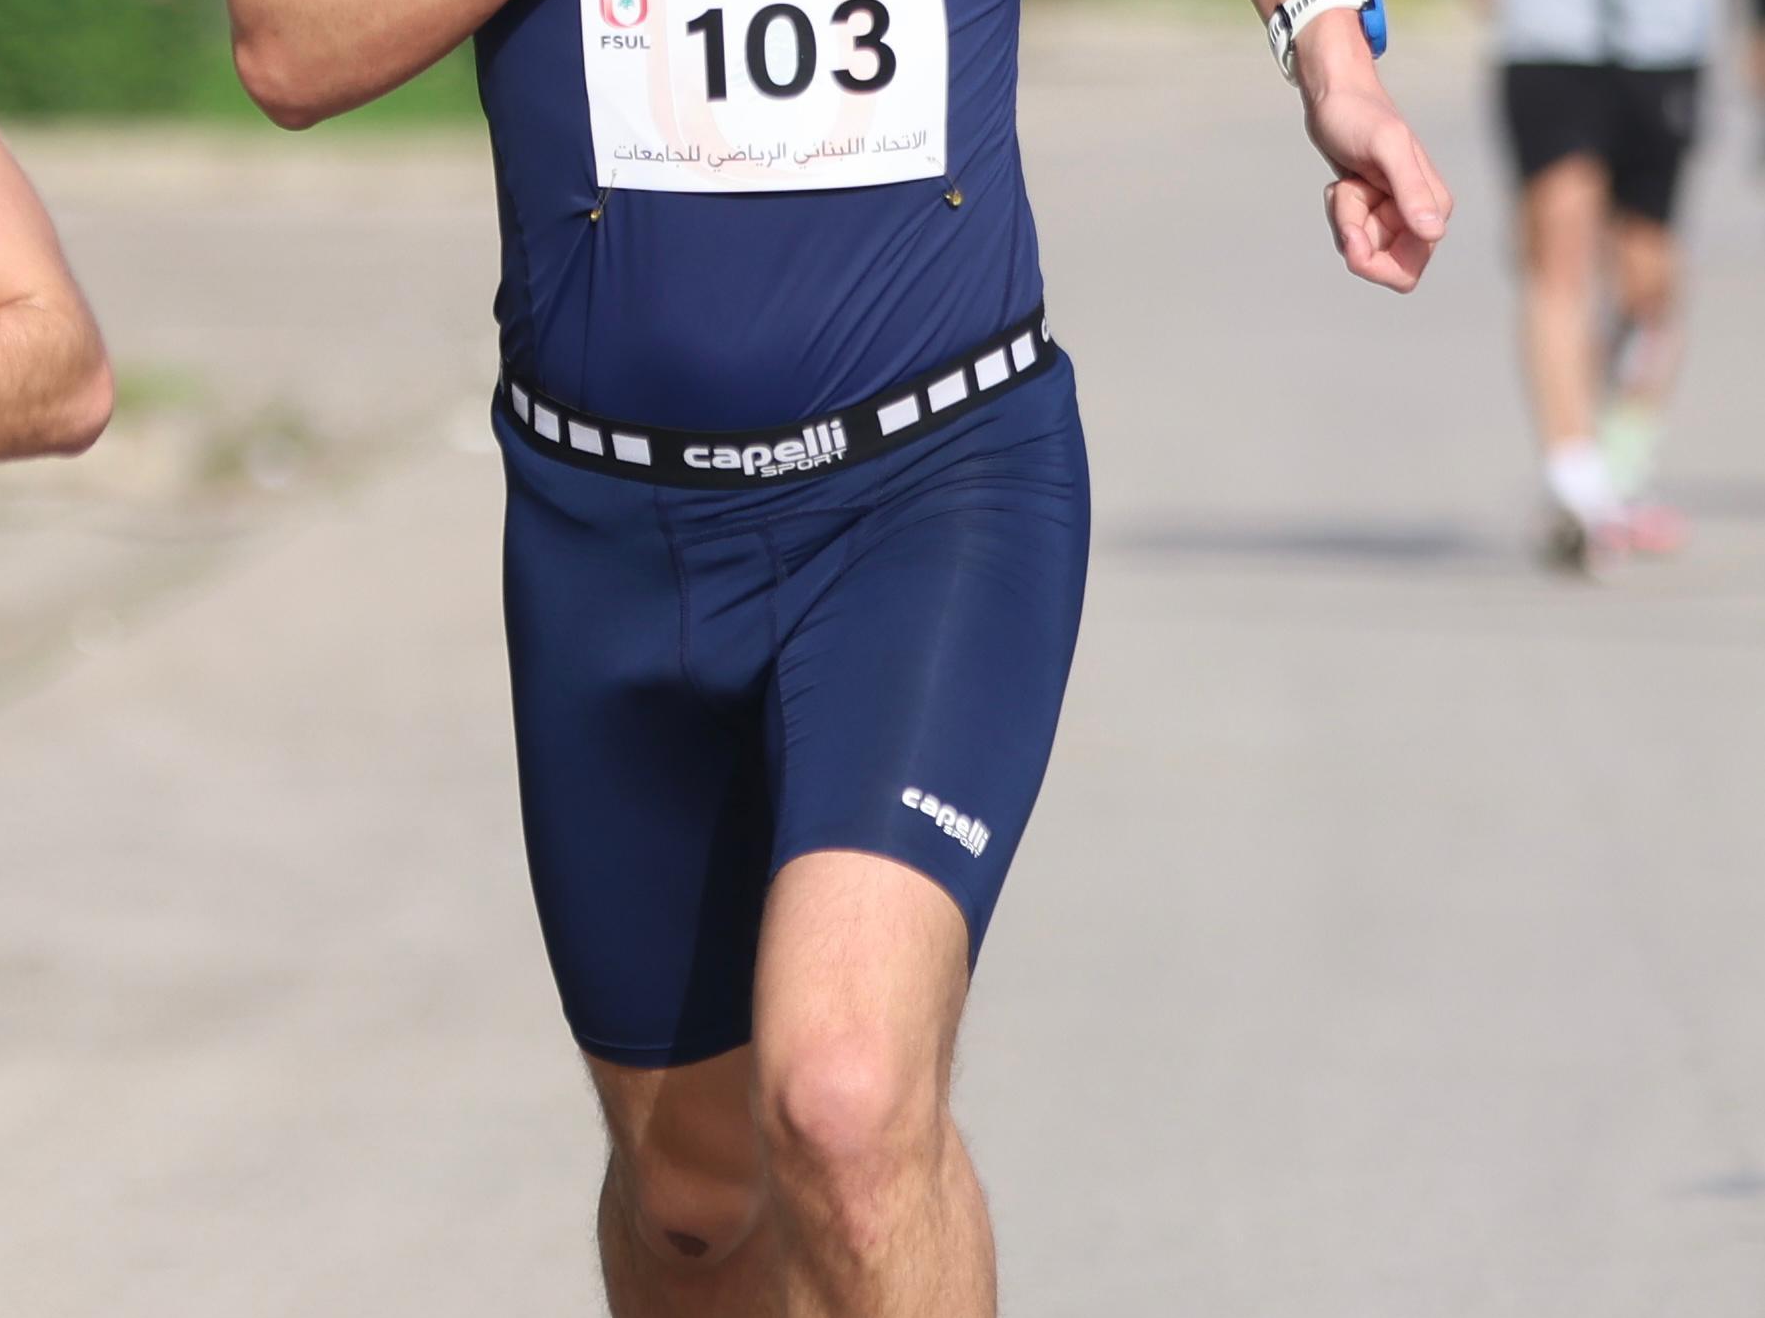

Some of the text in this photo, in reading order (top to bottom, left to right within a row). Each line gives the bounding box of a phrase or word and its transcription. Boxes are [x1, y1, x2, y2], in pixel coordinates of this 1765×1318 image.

[600, 35, 651, 50] FSUL
[613, 129, 927, 173] الاتحاد اللبناني الرياضي للجامعات
[683, 419, 848, 476] capelli
[760, 448, 847, 478] SPORT
[901, 786, 992, 856] capelli
[943, 825, 980, 858] SPORT
